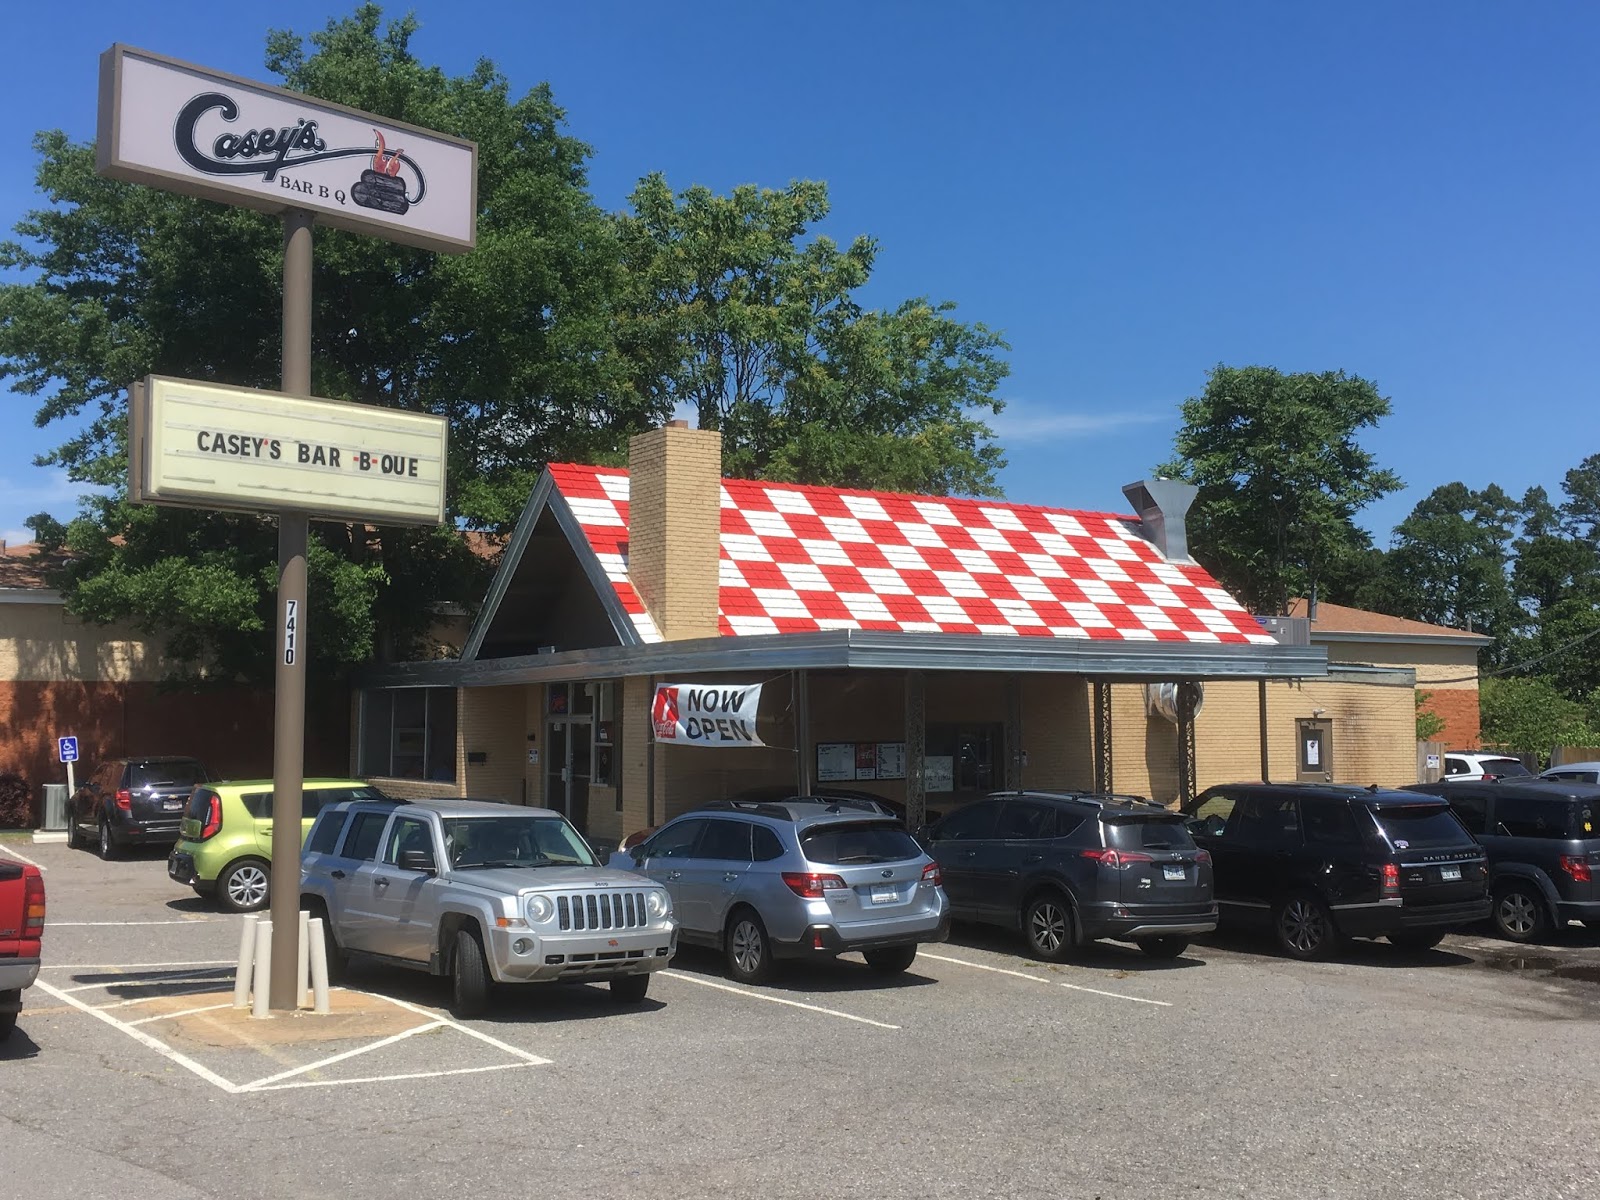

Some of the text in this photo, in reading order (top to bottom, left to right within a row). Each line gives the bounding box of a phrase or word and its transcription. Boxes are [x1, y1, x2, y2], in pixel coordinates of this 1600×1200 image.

[173, 92, 328, 183] Casey's
[280, 175, 347, 205] BAR B Q
[197, 431, 282, 460] CASEY'S
[298, 443, 341, 468] BAR
[285, 601, 297, 664] 7410
[687, 689, 746, 713] NOW
[685, 716, 753, 741] OPEN
